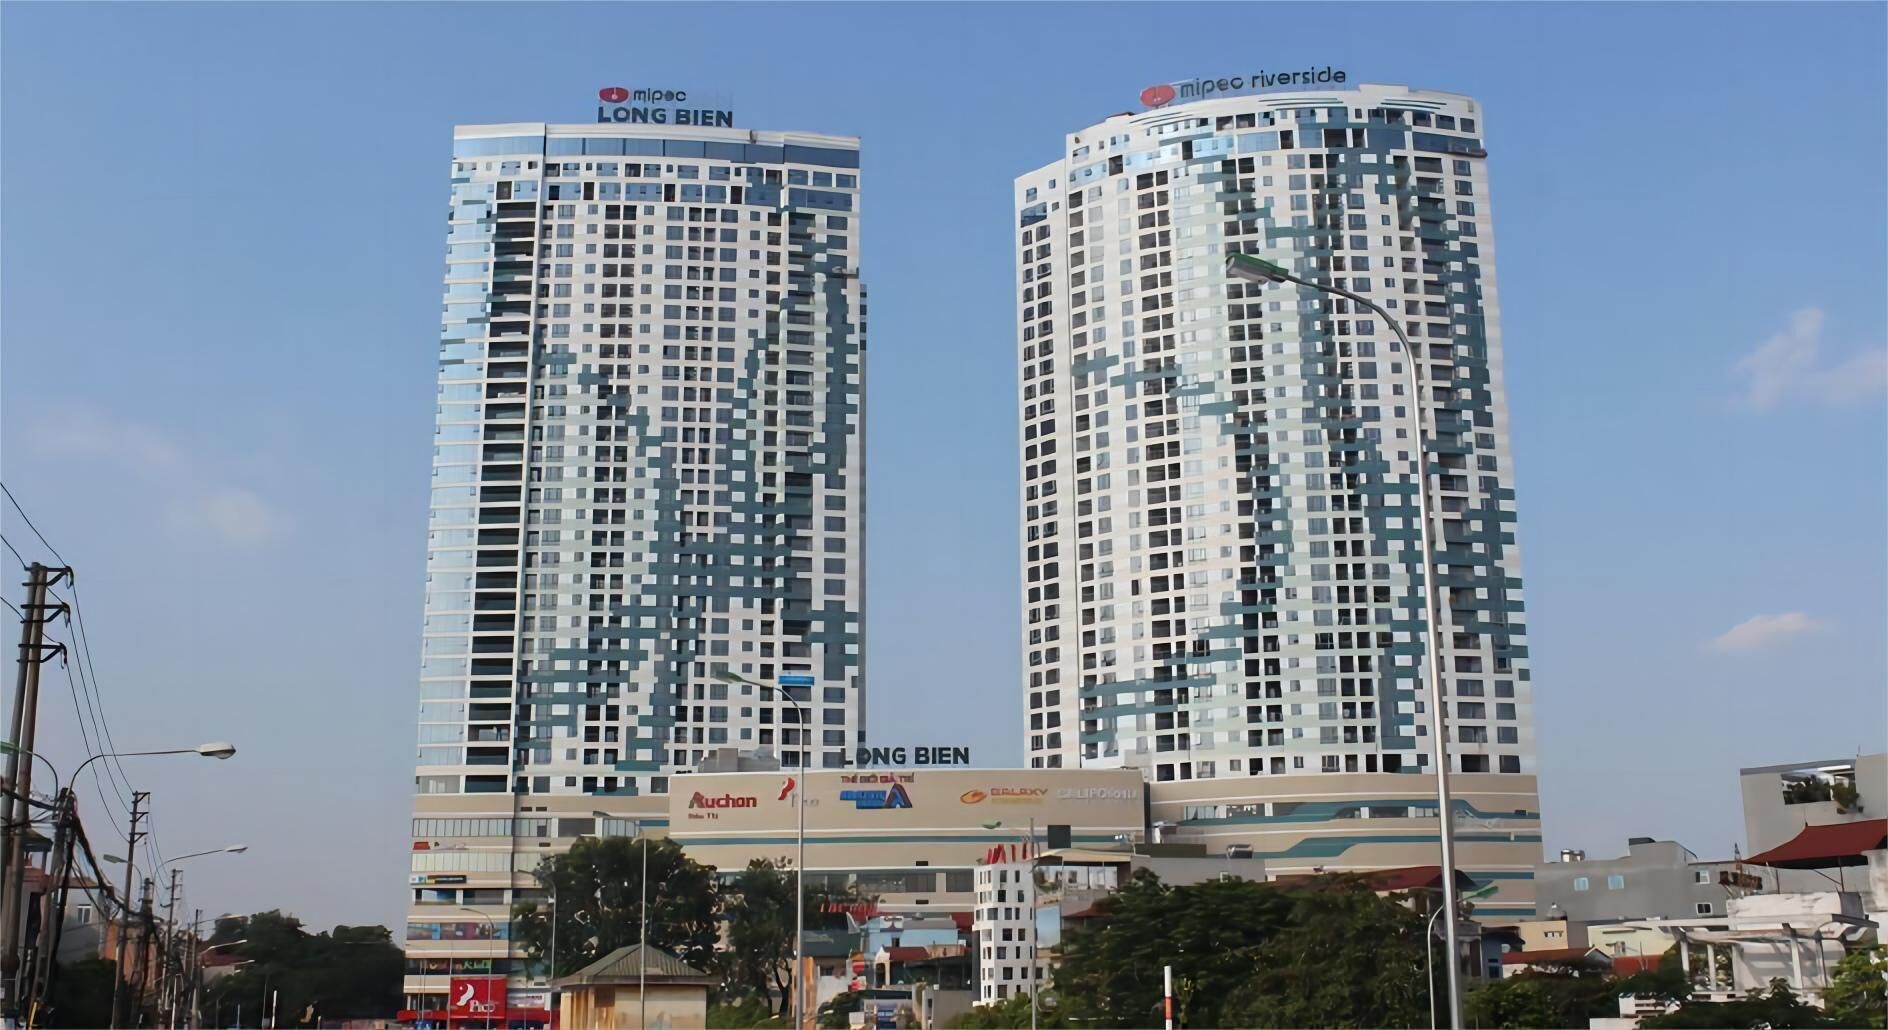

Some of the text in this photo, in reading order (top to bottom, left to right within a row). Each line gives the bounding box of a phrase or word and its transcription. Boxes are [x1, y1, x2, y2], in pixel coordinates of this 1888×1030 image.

[1251, 66, 1346, 88] riverside
[598, 106, 733, 128] LONG BIEN
[914, 746, 970, 765] BIEN
